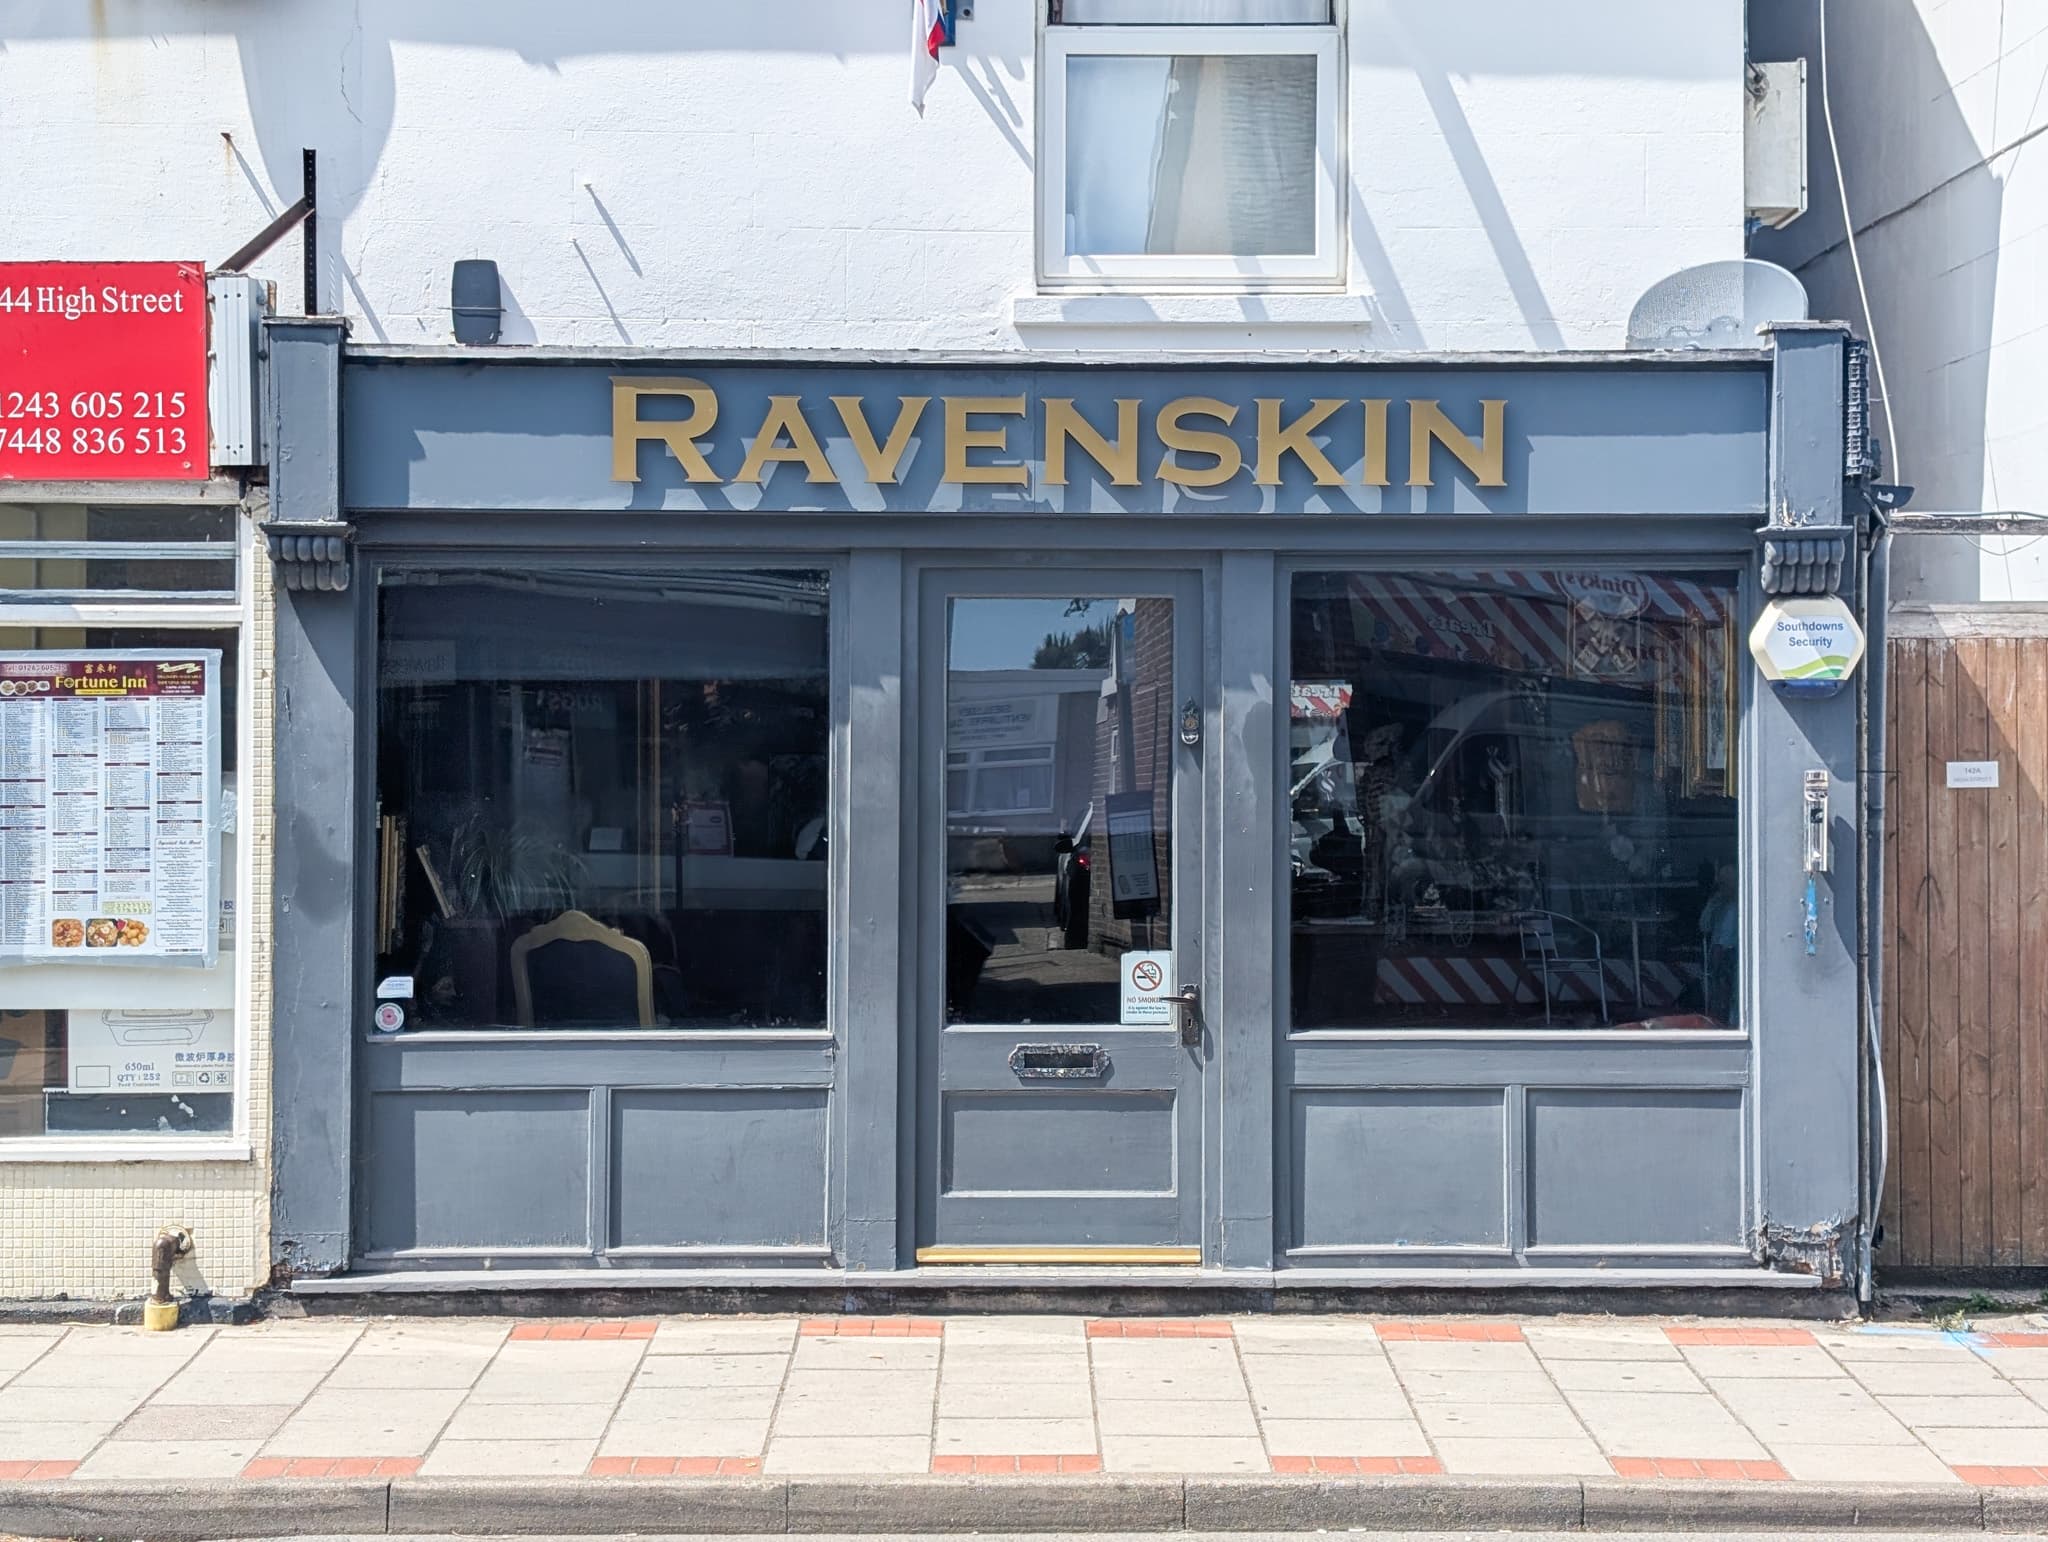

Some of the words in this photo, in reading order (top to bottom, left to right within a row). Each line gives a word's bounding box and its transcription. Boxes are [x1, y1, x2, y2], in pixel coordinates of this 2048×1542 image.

[36, 286, 97, 320] High
[102, 286, 184, 313] Street
[71, 391, 123, 419] 605
[133, 391, 186, 419] 215
[608, 375, 1509, 488] RAVENSKIN
[72, 427, 125, 455] 836
[135, 427, 187, 455] 513
[1777, 621, 1844, 632] Southdowns
[1788, 636, 1832, 649] Security
[55, 676, 118, 689] Fortune
[122, 676, 147, 689] Inn
[125, 1062, 155, 1071] 650ml
[143, 1073, 161, 1081] 252
